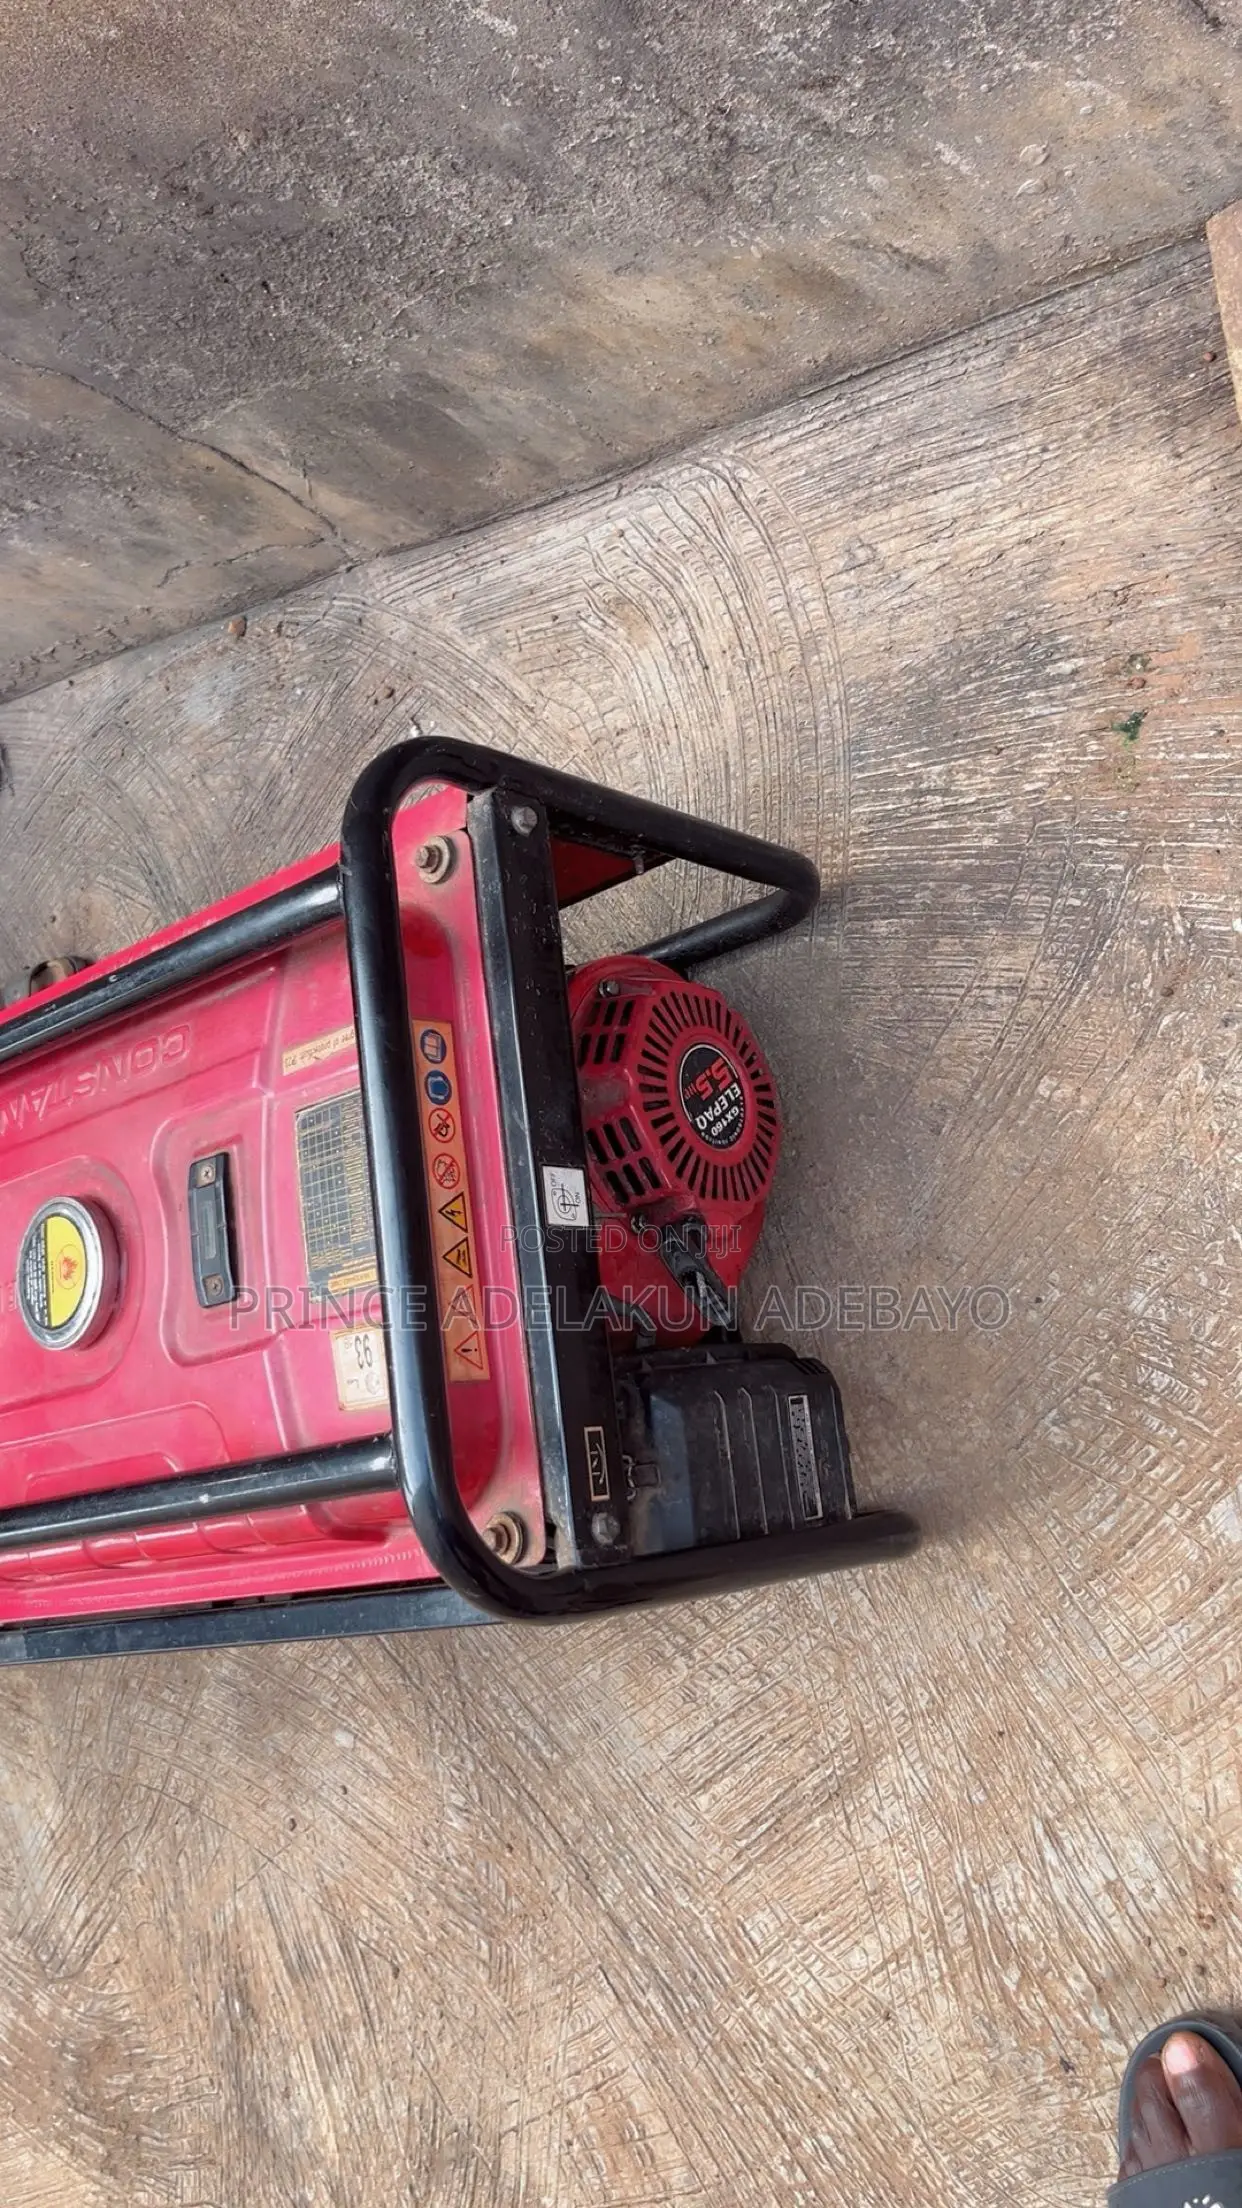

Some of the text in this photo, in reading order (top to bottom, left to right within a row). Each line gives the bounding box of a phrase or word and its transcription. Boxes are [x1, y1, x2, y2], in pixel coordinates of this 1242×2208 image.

[695, 1082, 741, 1130] ELEPAQ
[711, 1105, 740, 1136] GX160
[354, 1333, 373, 1369] 93
